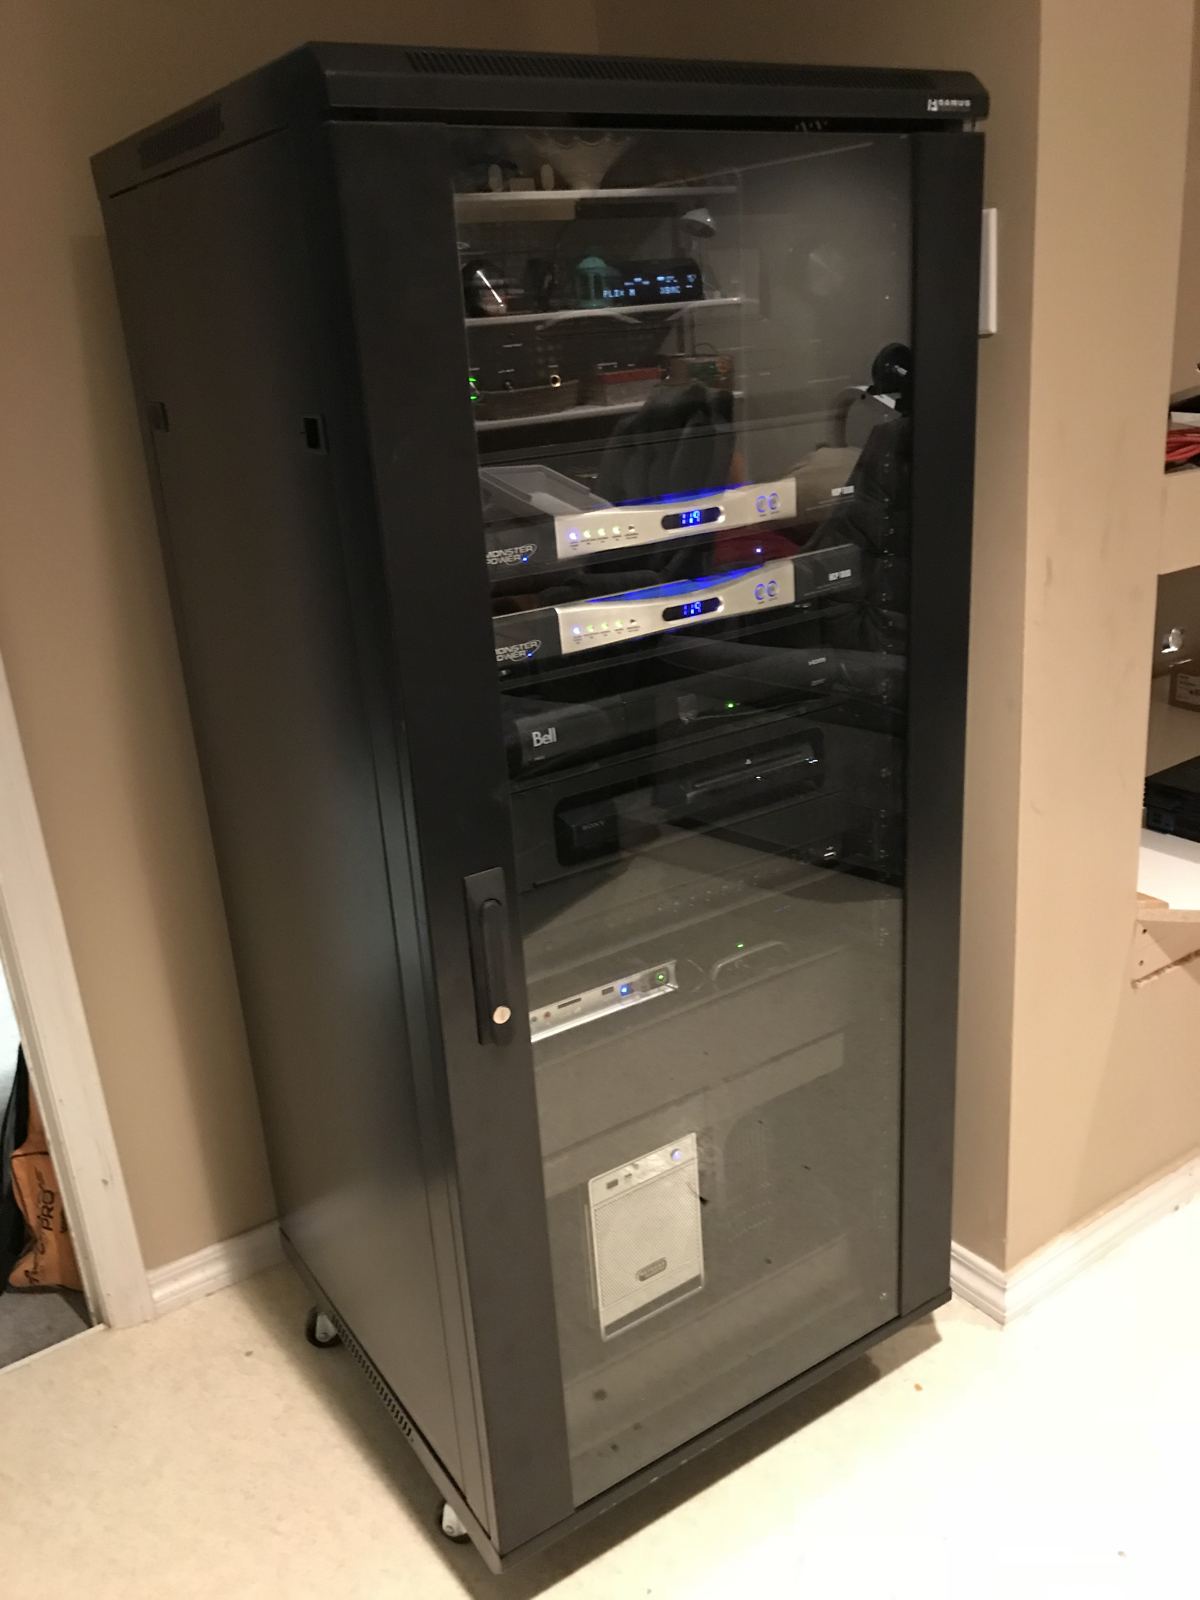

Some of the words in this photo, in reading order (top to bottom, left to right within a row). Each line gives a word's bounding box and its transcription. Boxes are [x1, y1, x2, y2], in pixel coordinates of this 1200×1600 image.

[682, 510, 700, 525] 119
[683, 601, 702, 616] 119
[496, 650, 526, 662] OWER
[531, 727, 557, 747] Bell
[41, 1189, 56, 1231] PRO
